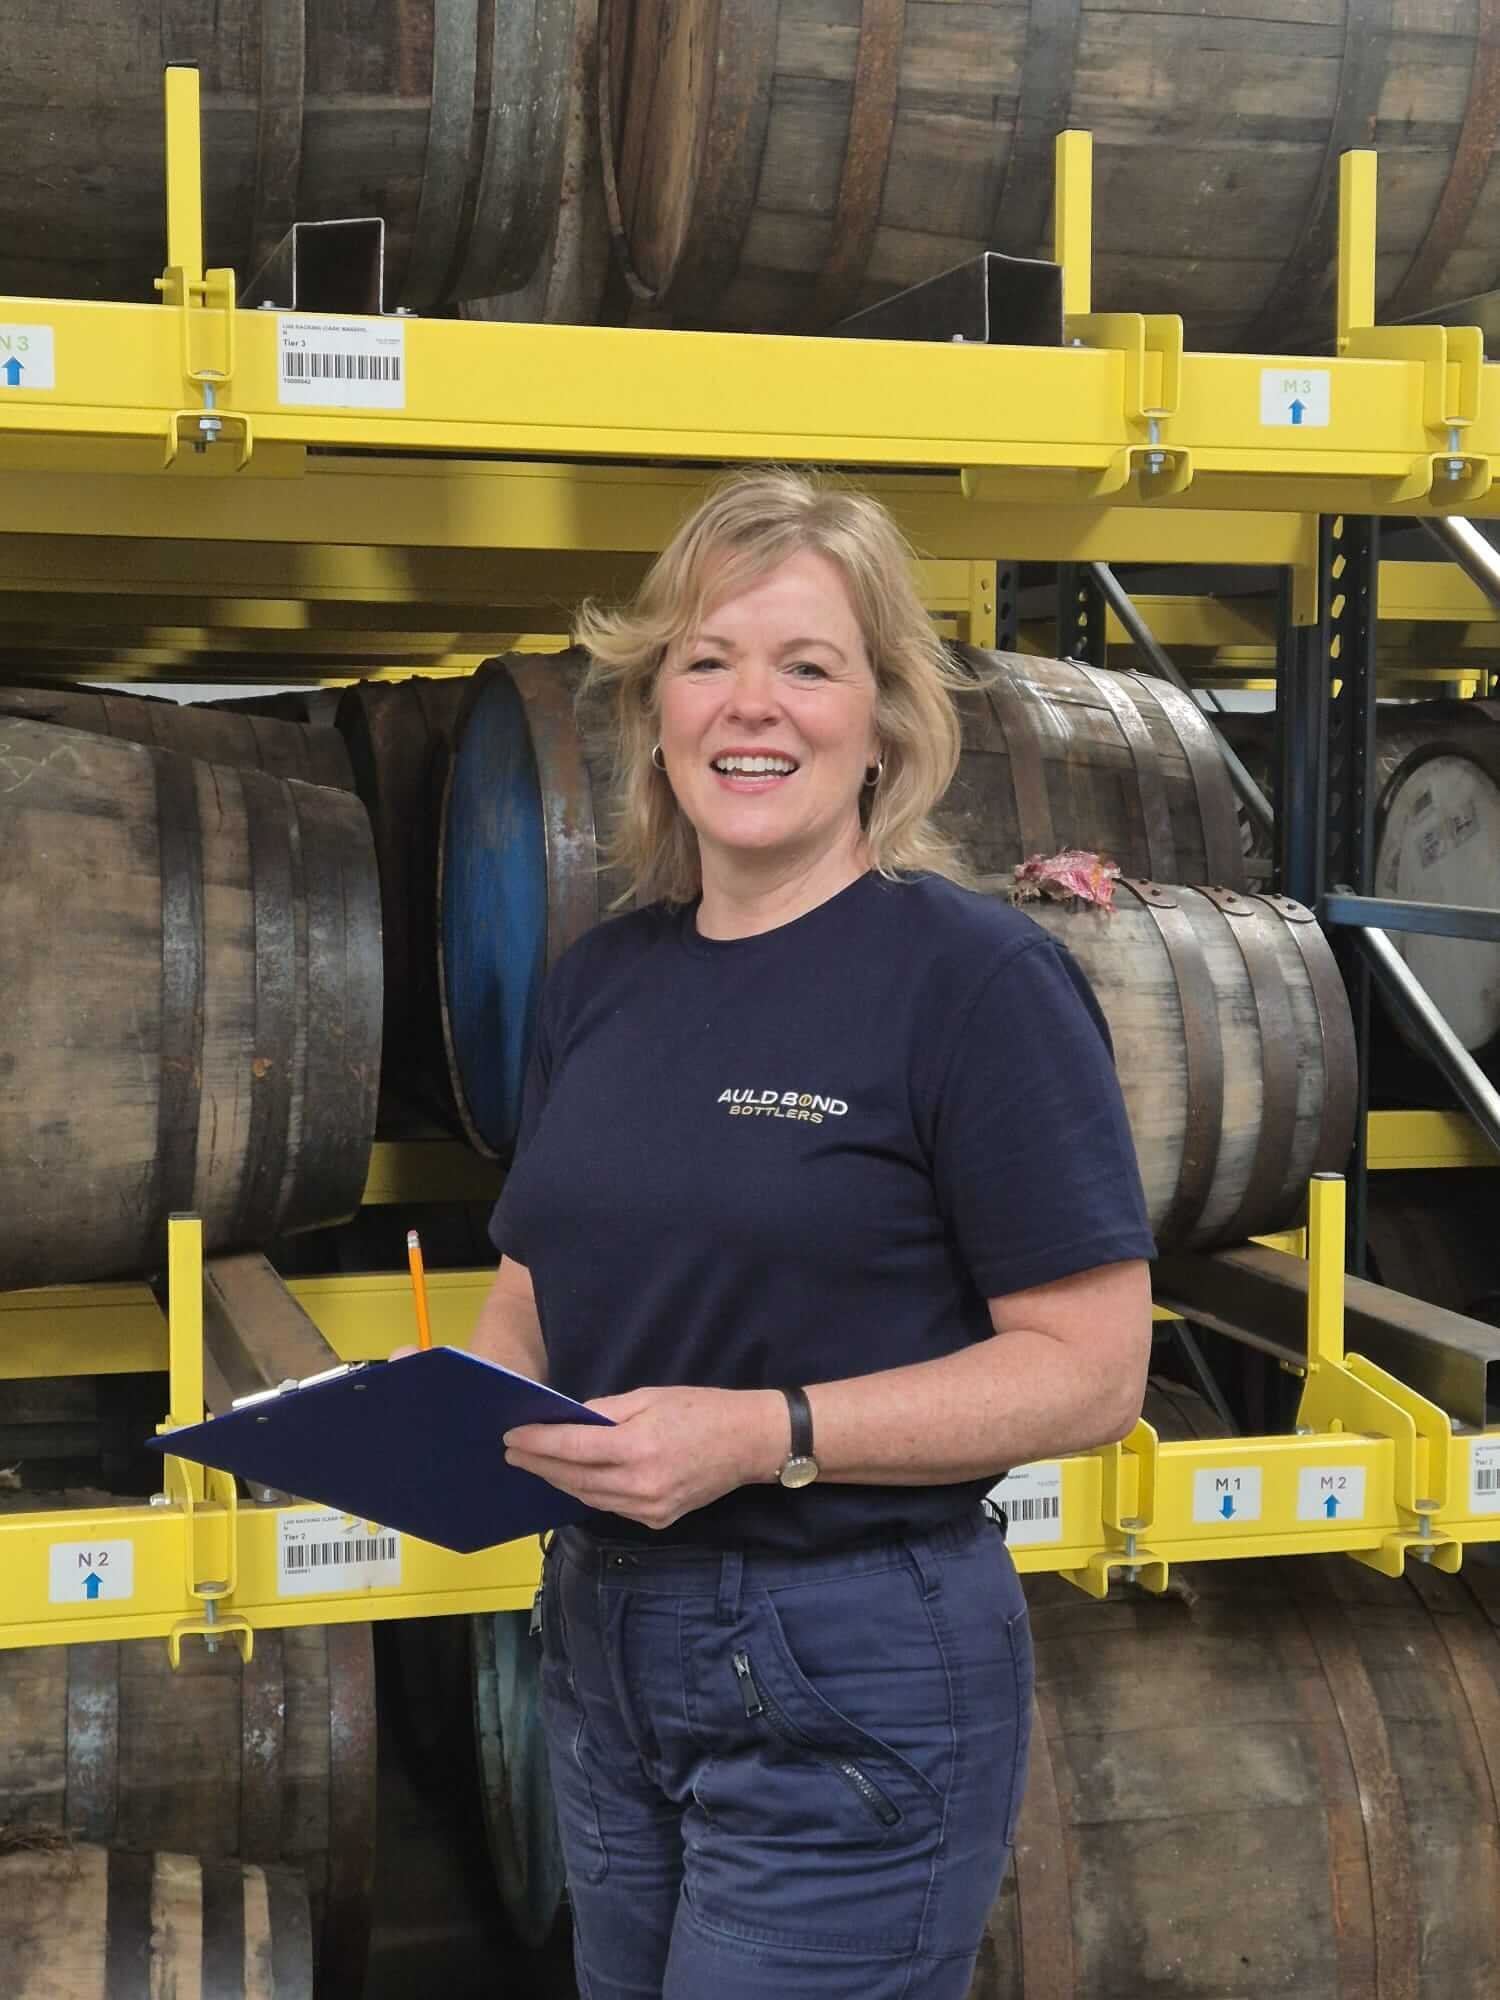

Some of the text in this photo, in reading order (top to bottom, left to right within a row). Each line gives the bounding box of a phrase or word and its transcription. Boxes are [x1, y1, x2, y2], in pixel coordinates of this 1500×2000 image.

[0, 336, 29, 351] N 3
[283, 338, 307, 347] Tier 3
[1283, 379, 1311, 393] M 3
[729, 1105, 825, 1123] BOTTLERS
[1215, 1478, 1241, 1491] M 1
[1320, 1476, 1347, 1489] M 2
[284, 1532, 306, 1541] Tier 2
[78, 1552, 109, 1568] N 2
